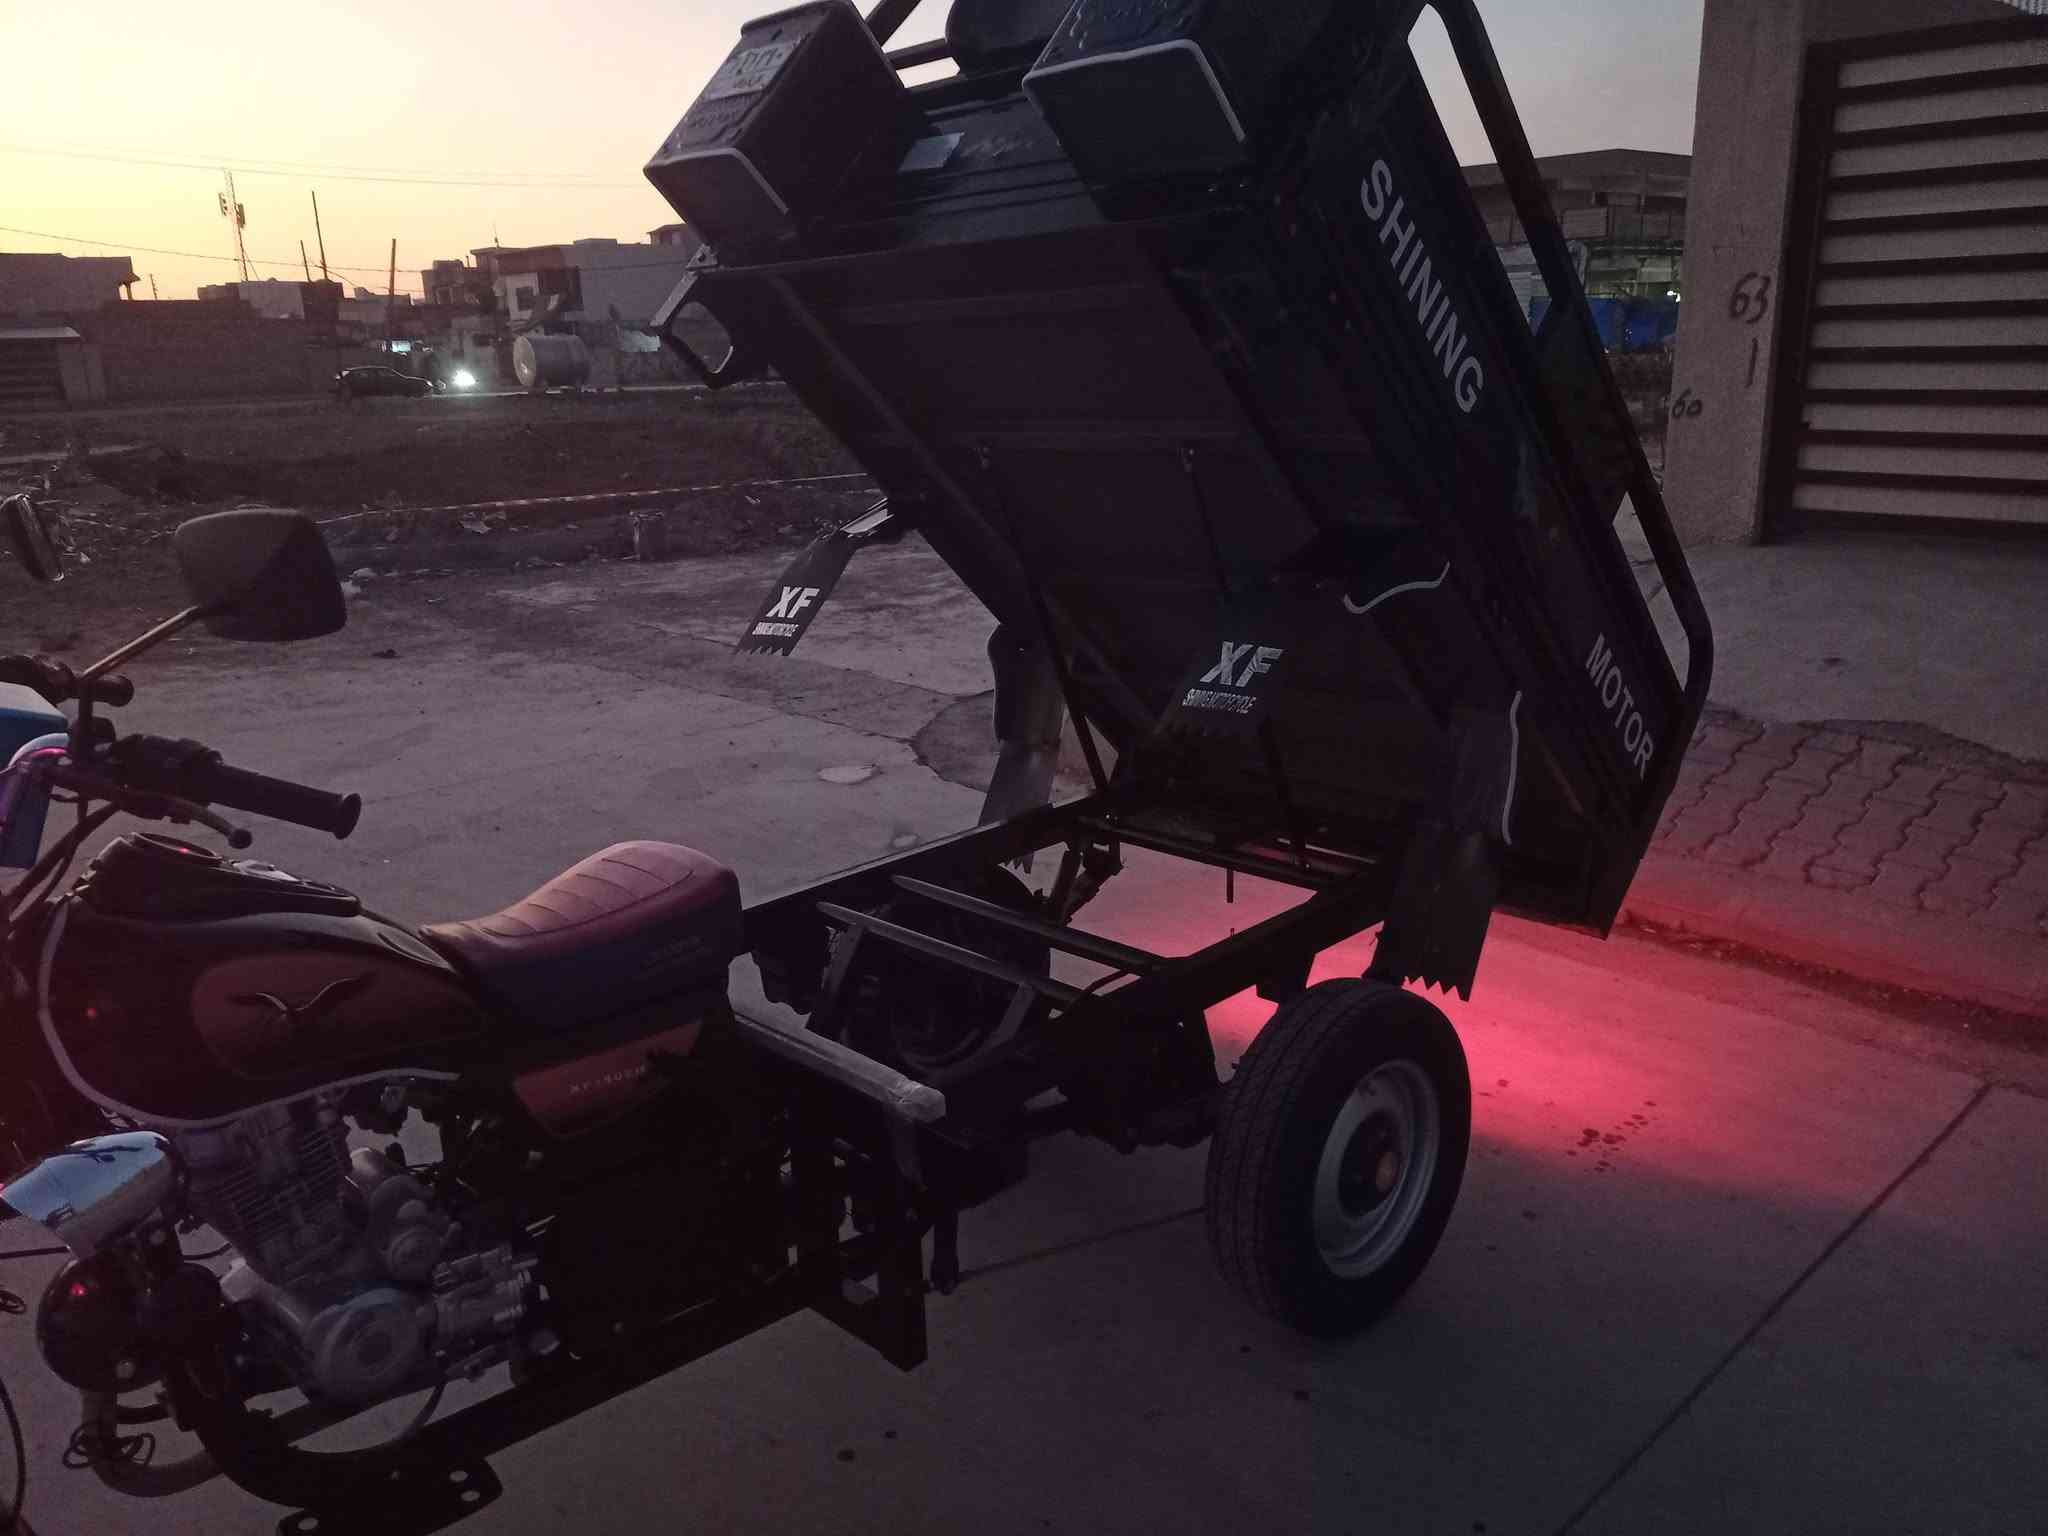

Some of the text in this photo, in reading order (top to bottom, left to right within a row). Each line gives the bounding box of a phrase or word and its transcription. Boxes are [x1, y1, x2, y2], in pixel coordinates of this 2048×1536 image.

[1360, 159, 1484, 413] SHINING
[1730, 271, 1771, 325] 63
[765, 586, 820, 618] XF
[1199, 640, 1284, 688] XF
[1585, 632, 1654, 782] MOTOR
